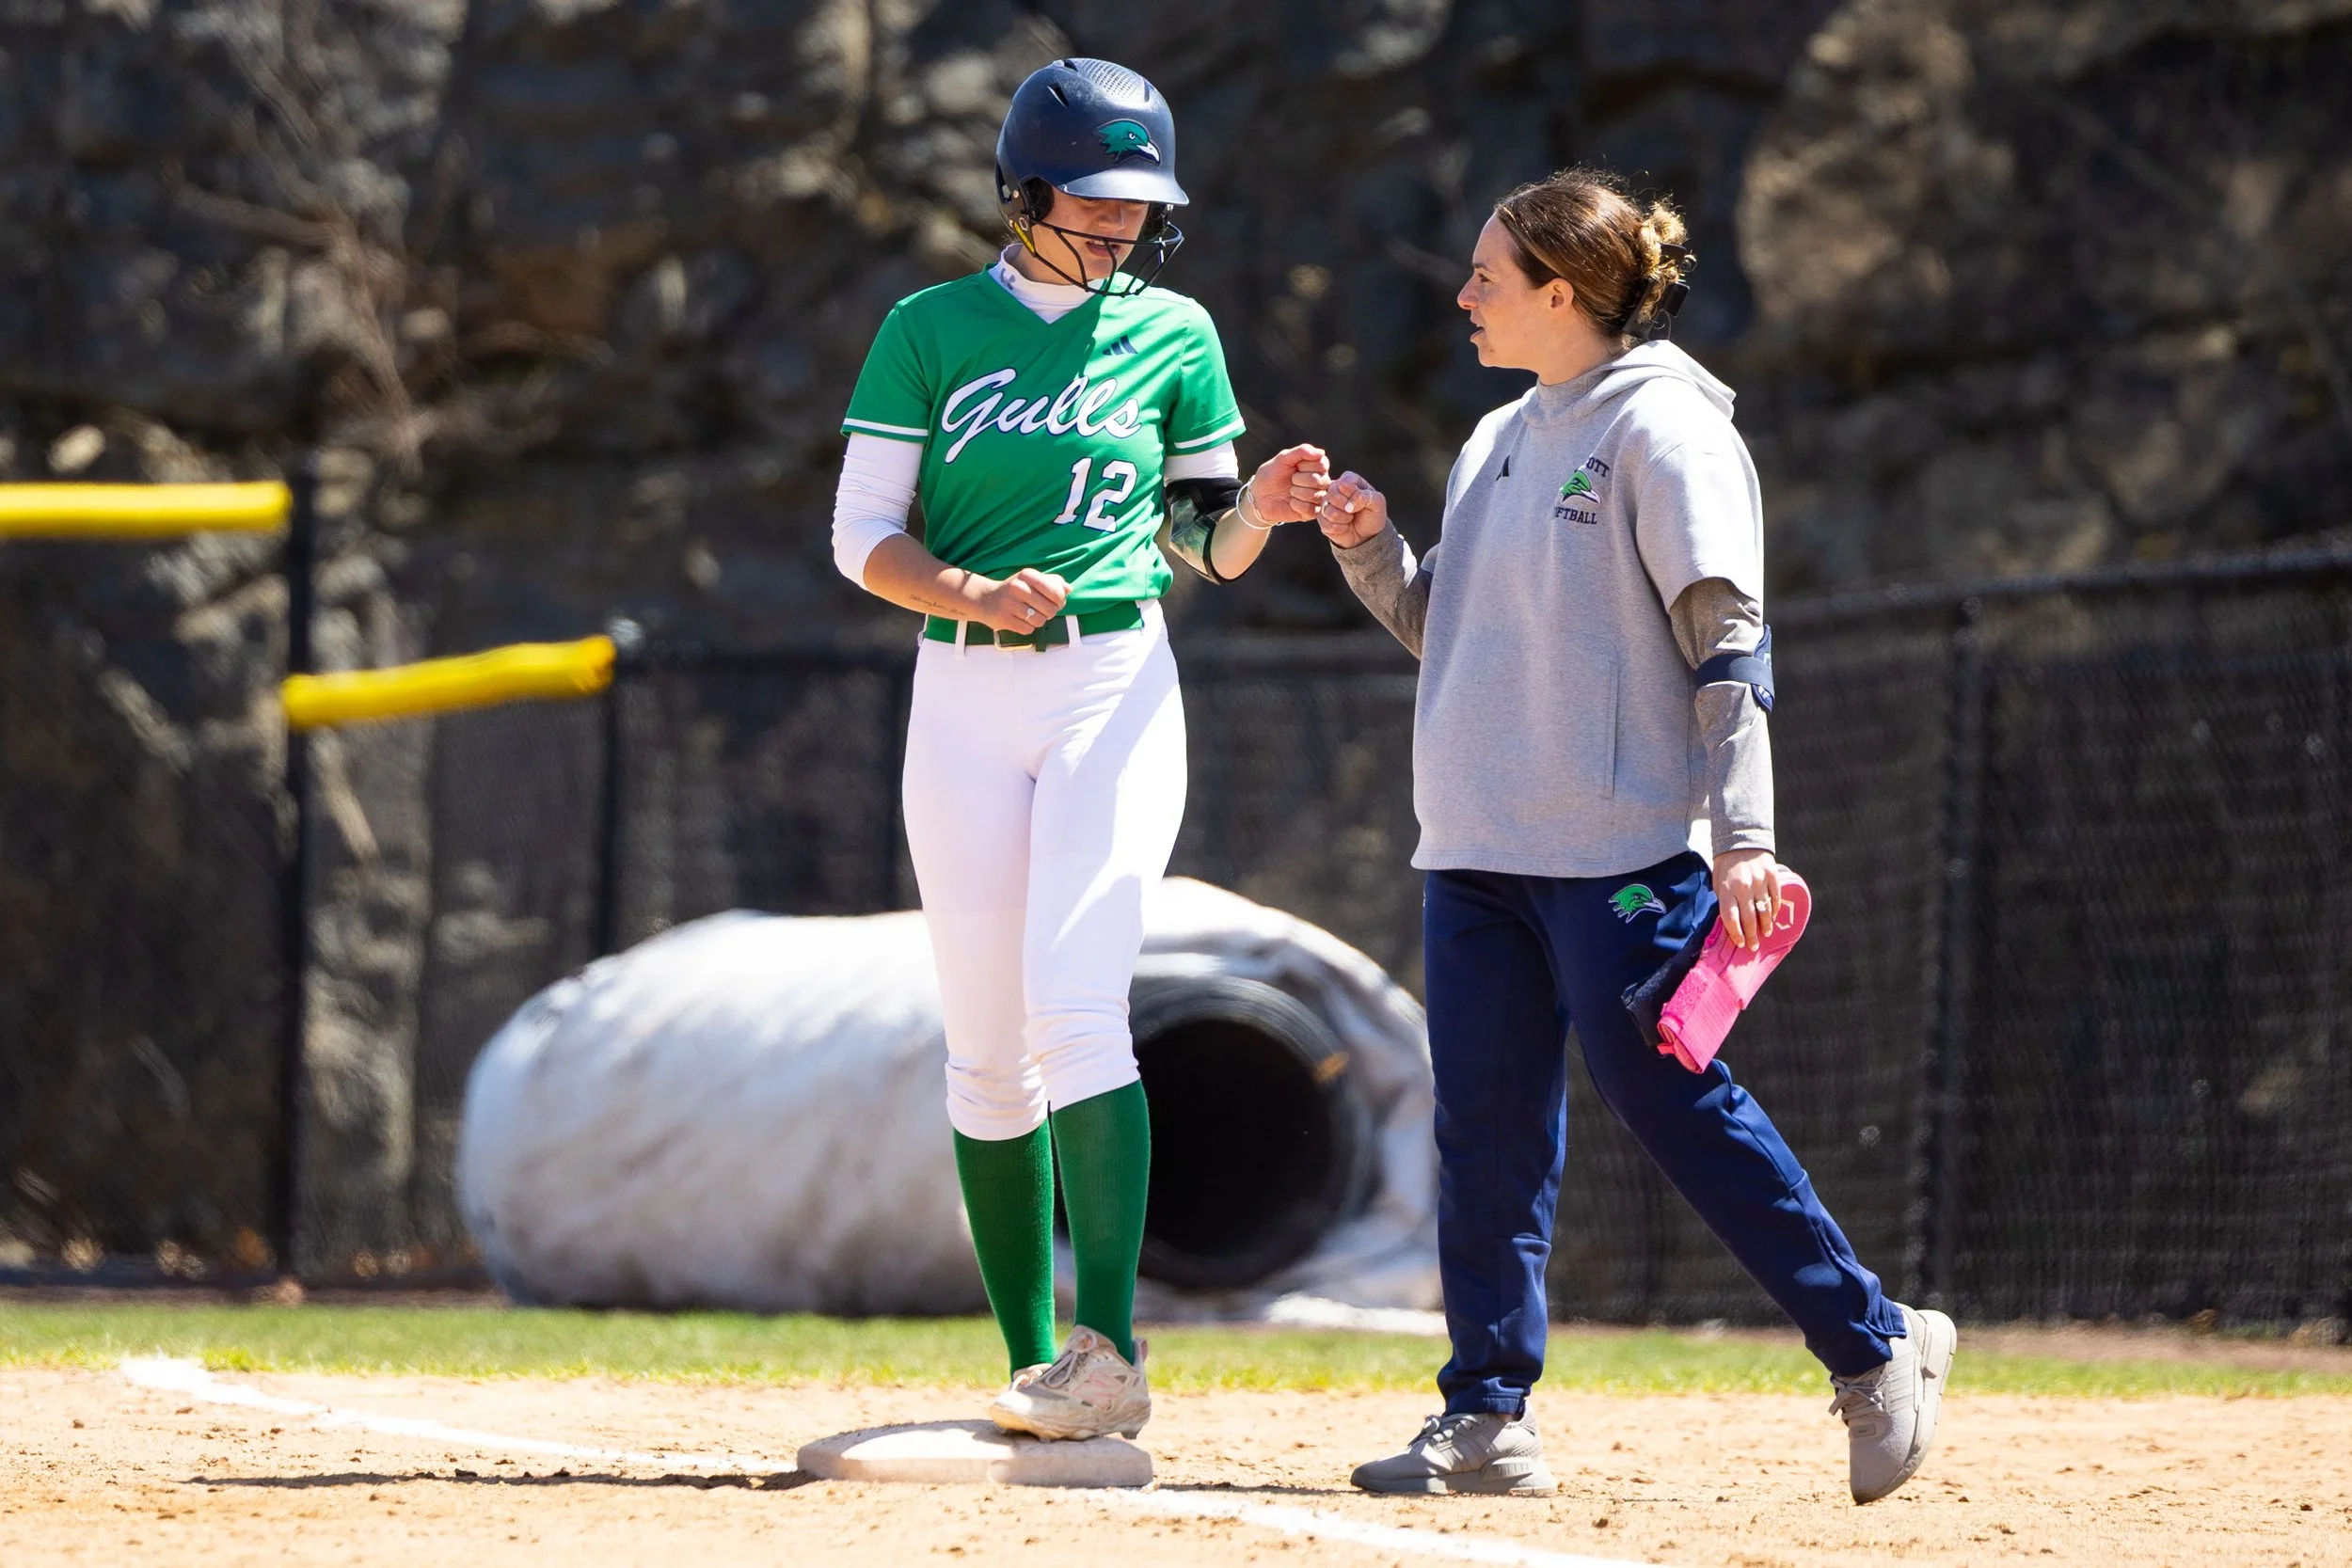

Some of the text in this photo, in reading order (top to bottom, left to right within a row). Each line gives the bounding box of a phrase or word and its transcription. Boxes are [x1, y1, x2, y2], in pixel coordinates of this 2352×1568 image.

[942, 368, 1141, 465] Gulls
[1053, 457, 1138, 532] 12
[1554, 506, 1597, 525] FTBALL
